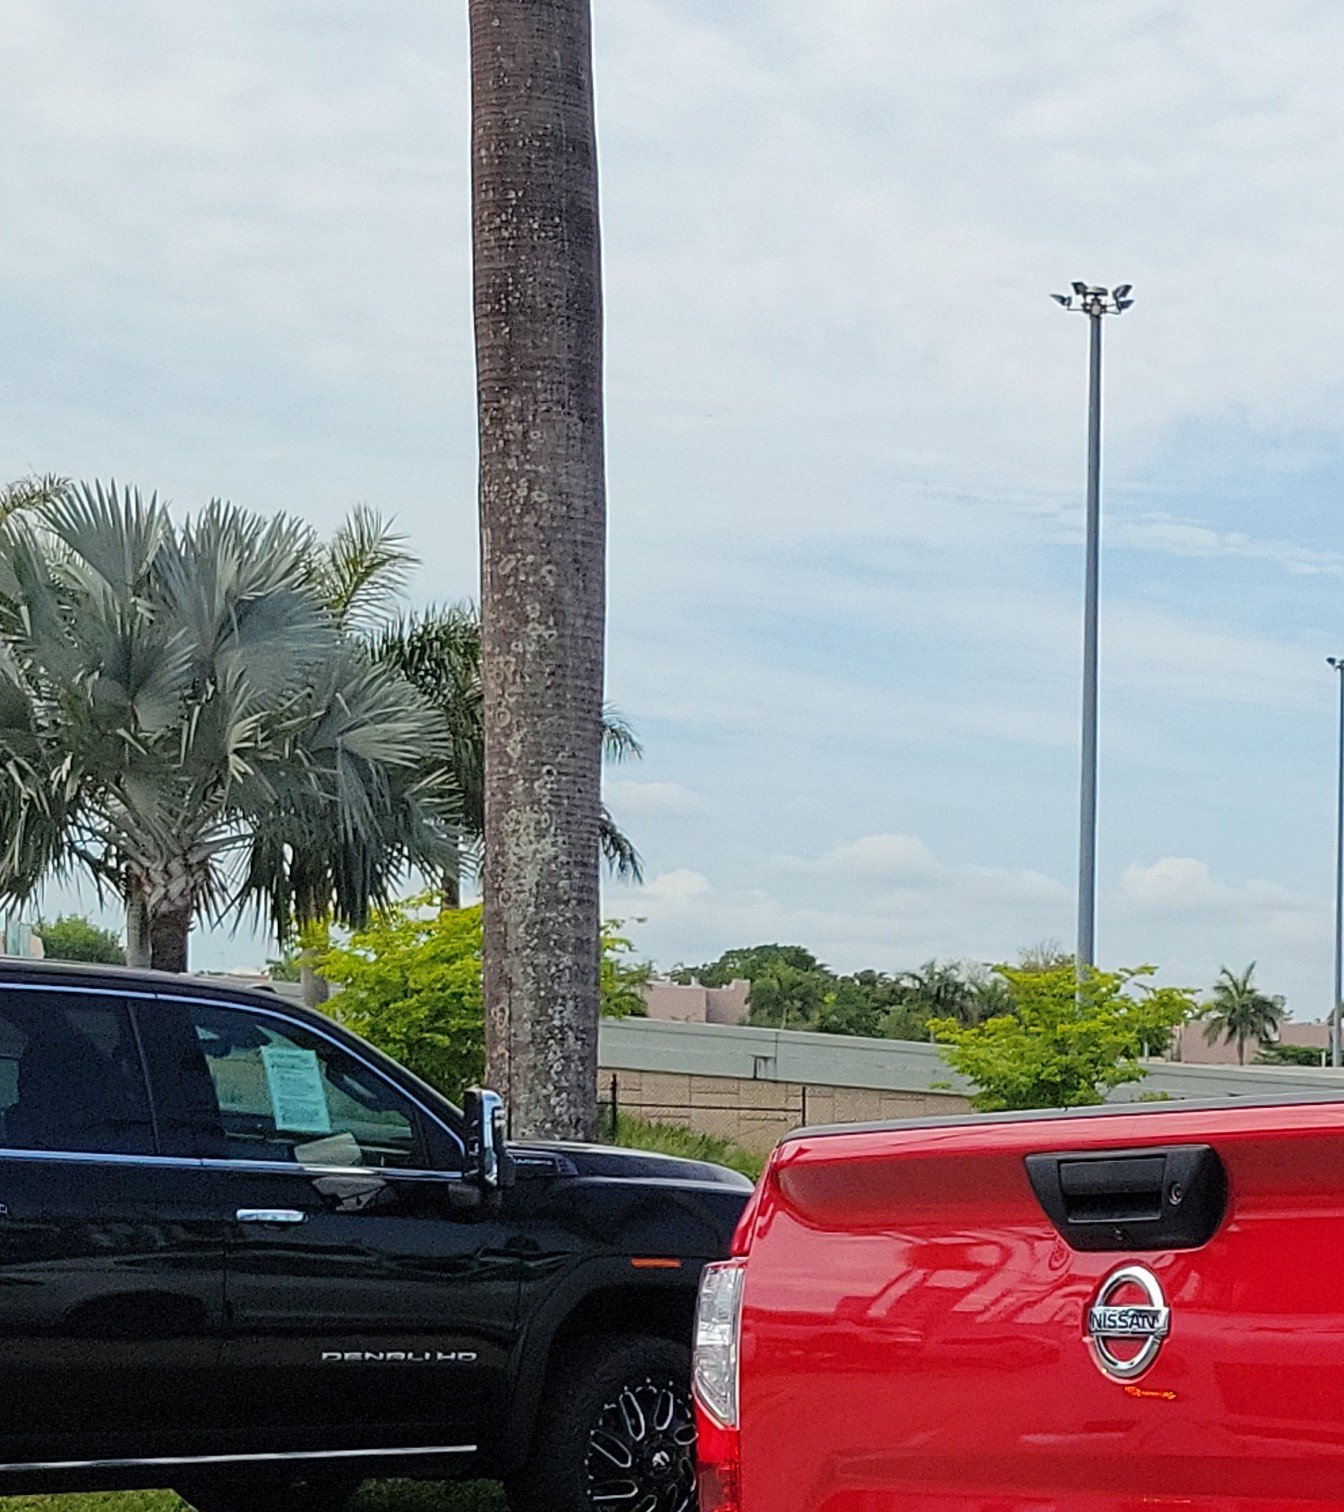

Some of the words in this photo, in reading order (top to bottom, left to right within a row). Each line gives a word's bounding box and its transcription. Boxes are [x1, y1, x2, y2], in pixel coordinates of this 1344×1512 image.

[1090, 1310, 1156, 1330] NISSAN
[321, 1351, 431, 1362] DENALI
[436, 1351, 478, 1362] HD
